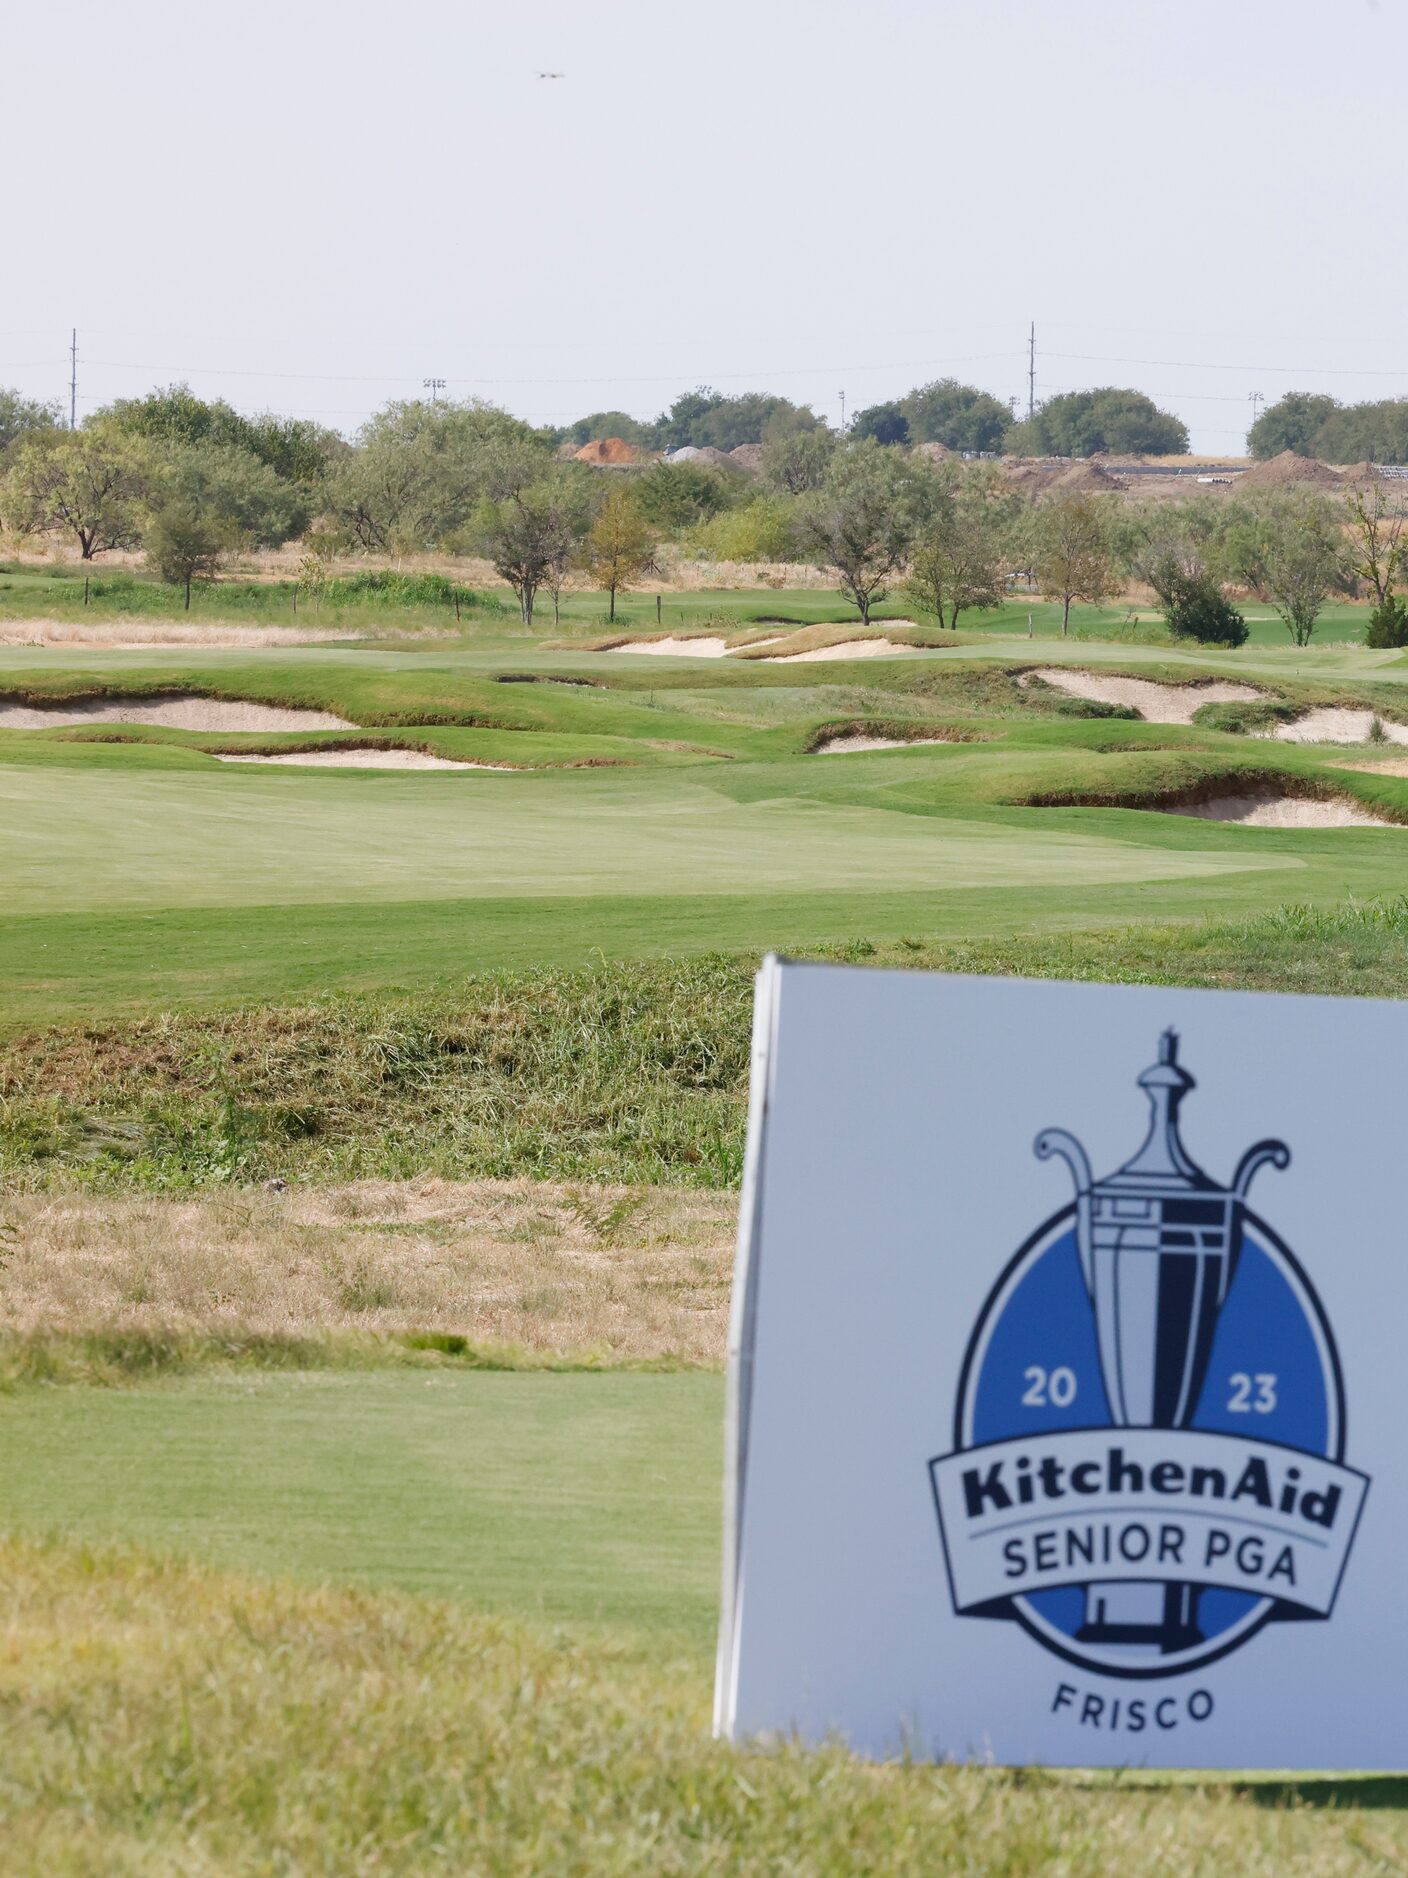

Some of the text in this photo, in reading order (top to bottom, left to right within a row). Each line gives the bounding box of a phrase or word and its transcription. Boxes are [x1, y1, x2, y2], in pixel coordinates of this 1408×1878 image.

[1021, 1366, 1278, 1414] 20 23
[961, 1447, 1343, 1530] KitchenAid
[1003, 1522, 1298, 1587] SENIOR PGA
[1051, 1682, 1216, 1733] FRISCO
